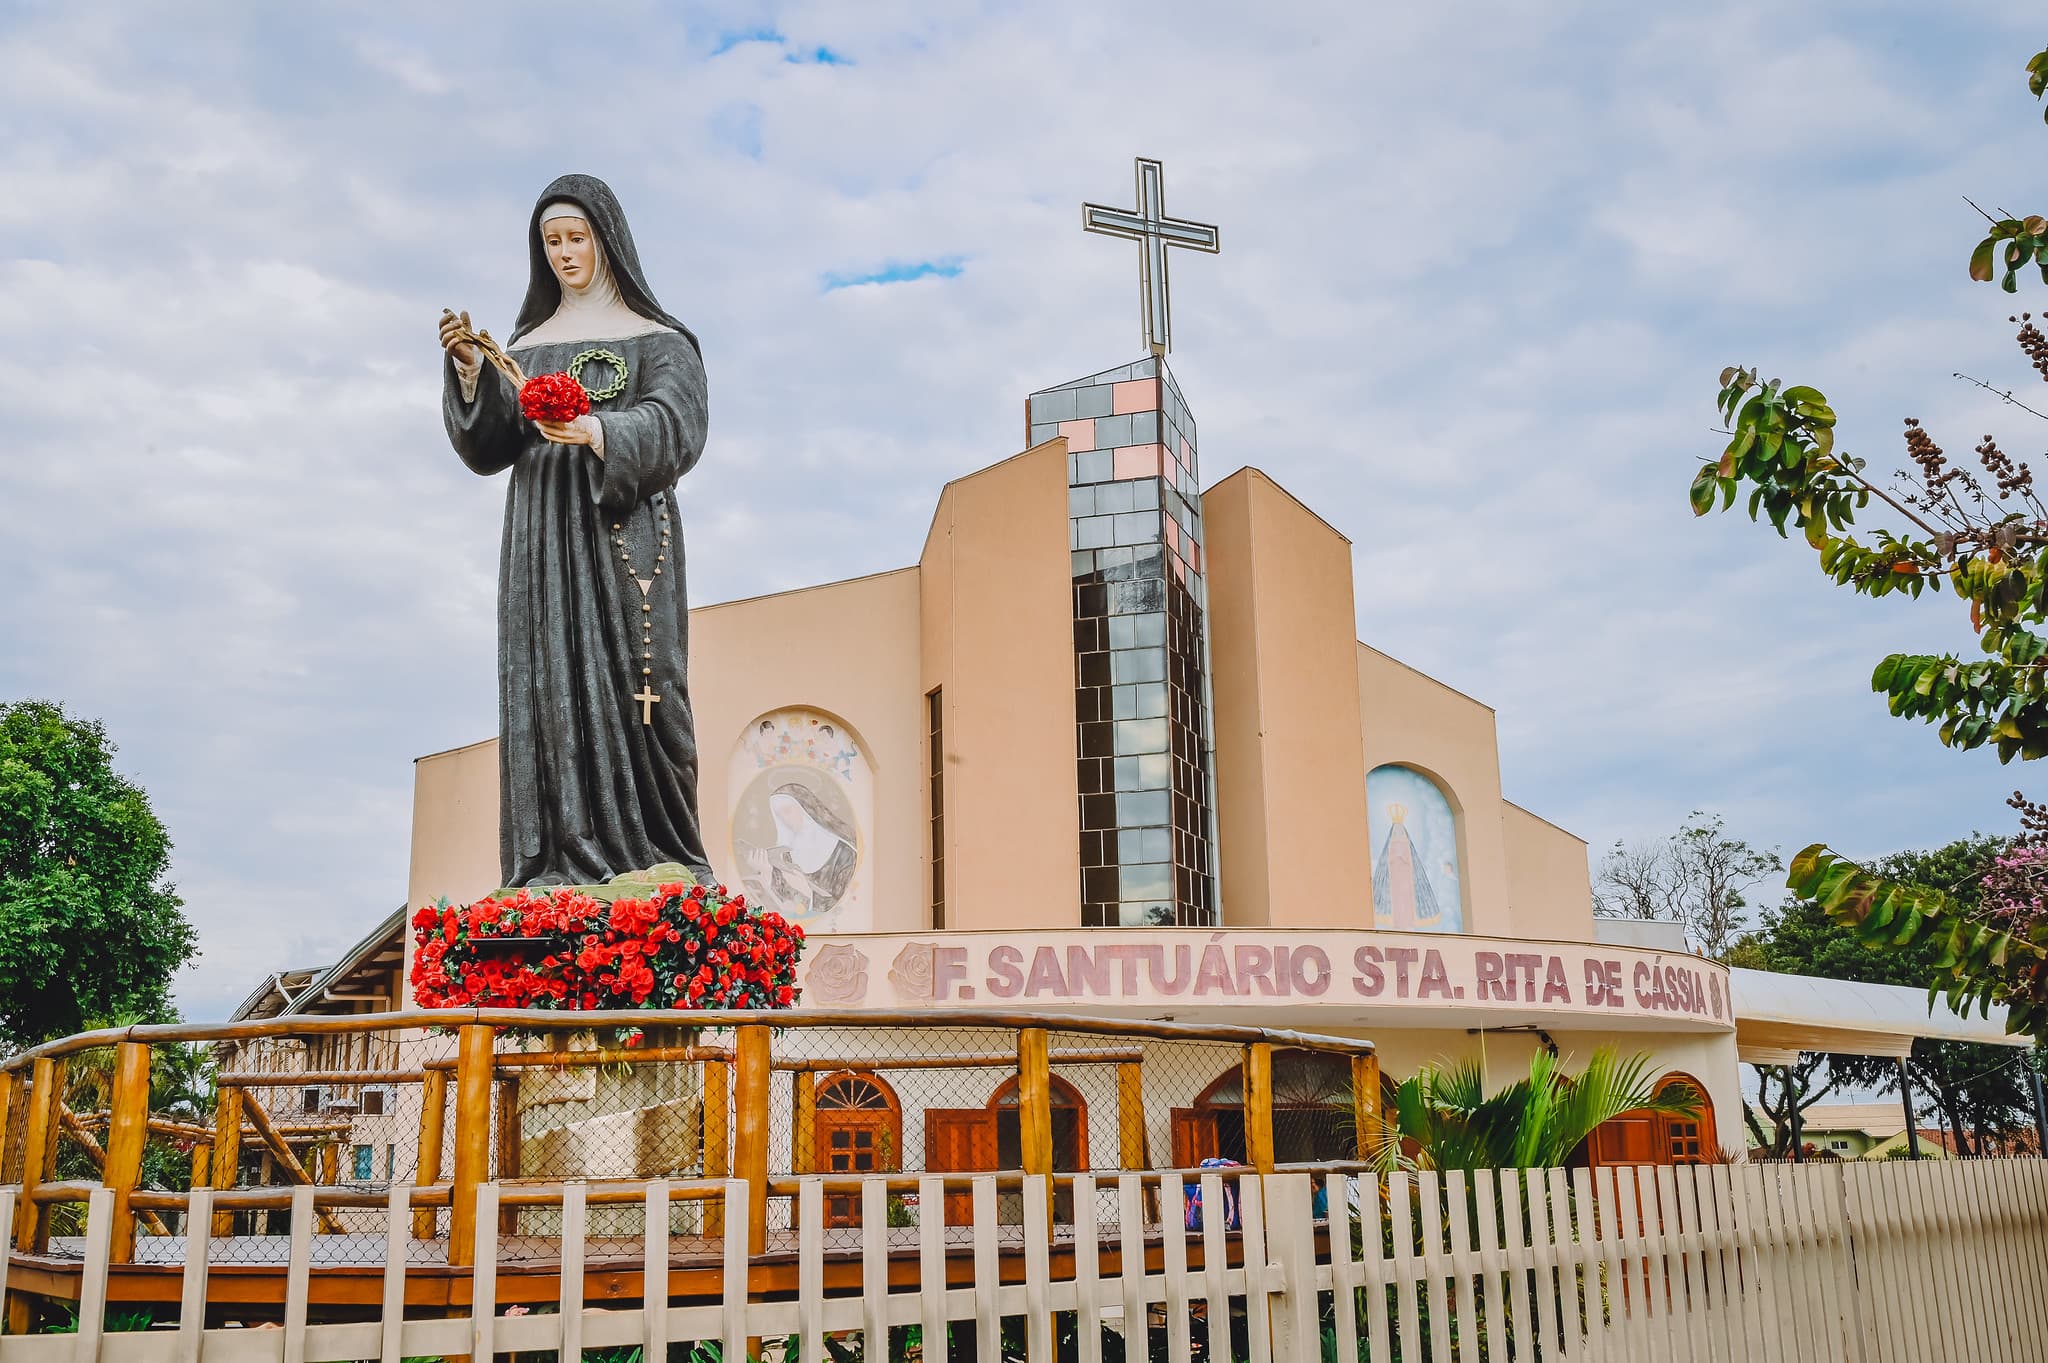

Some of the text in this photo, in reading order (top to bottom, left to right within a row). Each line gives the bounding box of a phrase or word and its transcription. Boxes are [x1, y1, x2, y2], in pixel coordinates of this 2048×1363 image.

[986, 932, 1331, 998] SANTUÁRIO
[1352, 945, 1465, 1000] STA.
[1475, 951, 1572, 1004] RITA
[1584, 958, 1625, 1008] DE
[1633, 955, 1708, 1015] CÁSSIA
